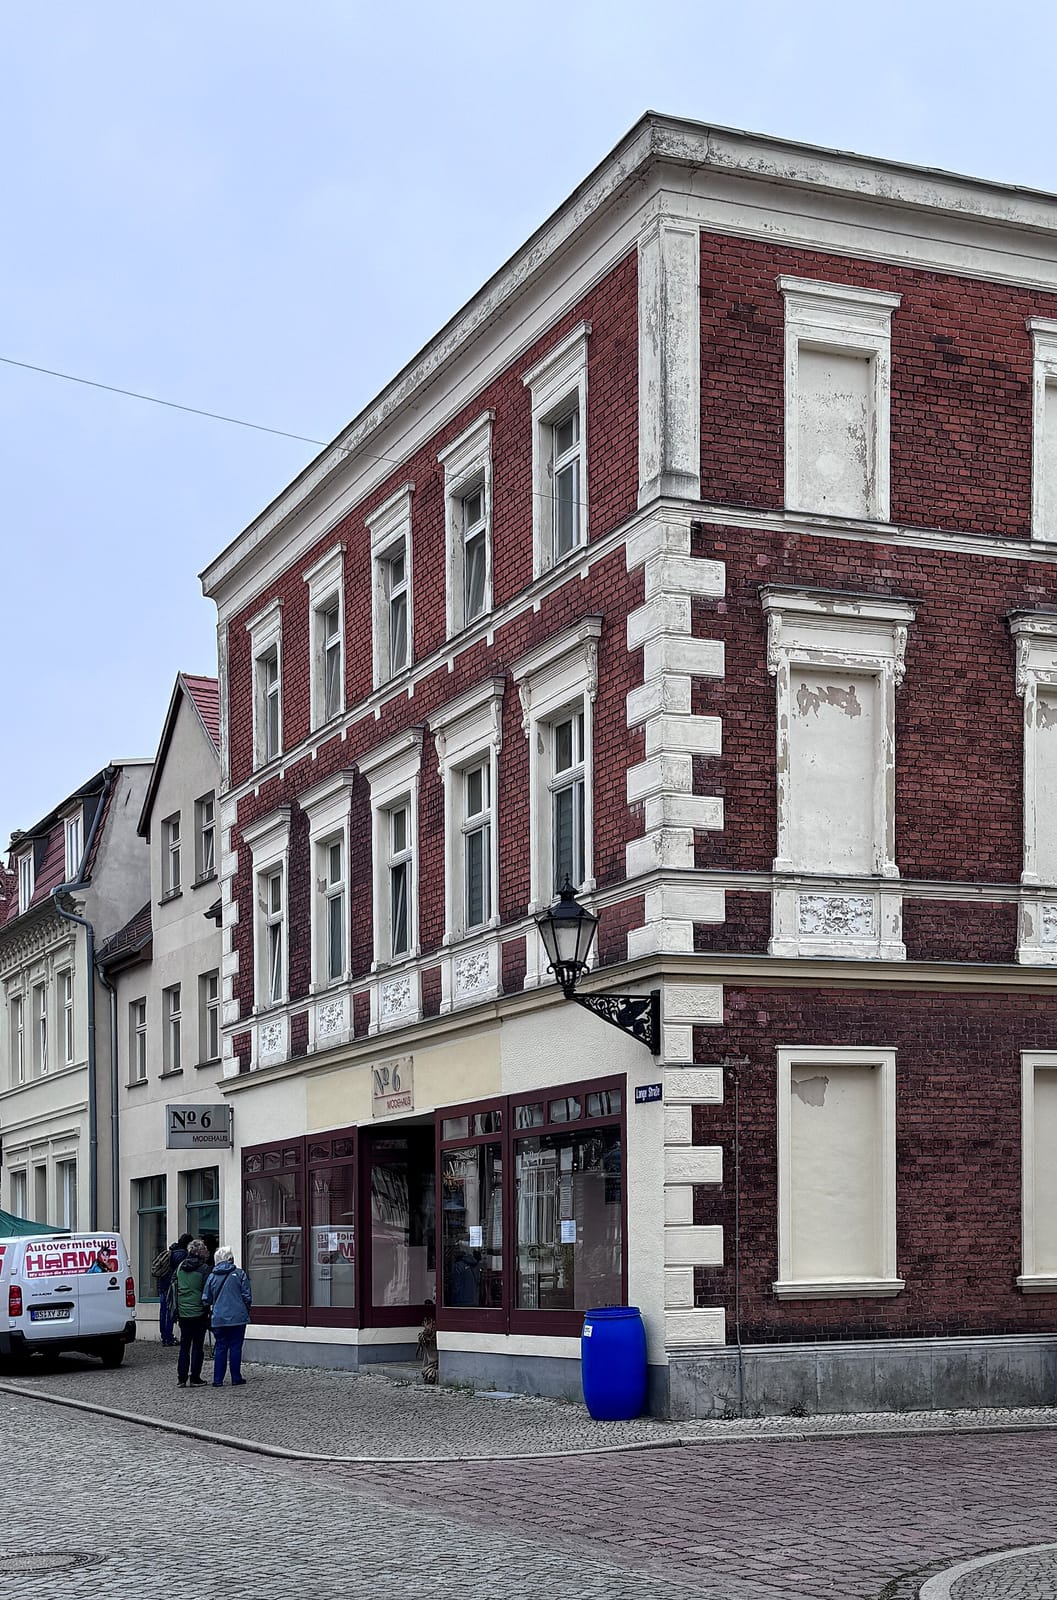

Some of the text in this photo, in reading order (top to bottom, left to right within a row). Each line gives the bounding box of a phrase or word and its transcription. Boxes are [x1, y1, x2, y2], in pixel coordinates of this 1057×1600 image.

[391, 1064, 401, 1092] 6
[386, 1096, 411, 1110] MODEHAUS
[200, 1110, 212, 1128] 6
[192, 1135, 228, 1143] MODEHAUS
[26, 1240, 117, 1252] Autovermietung
